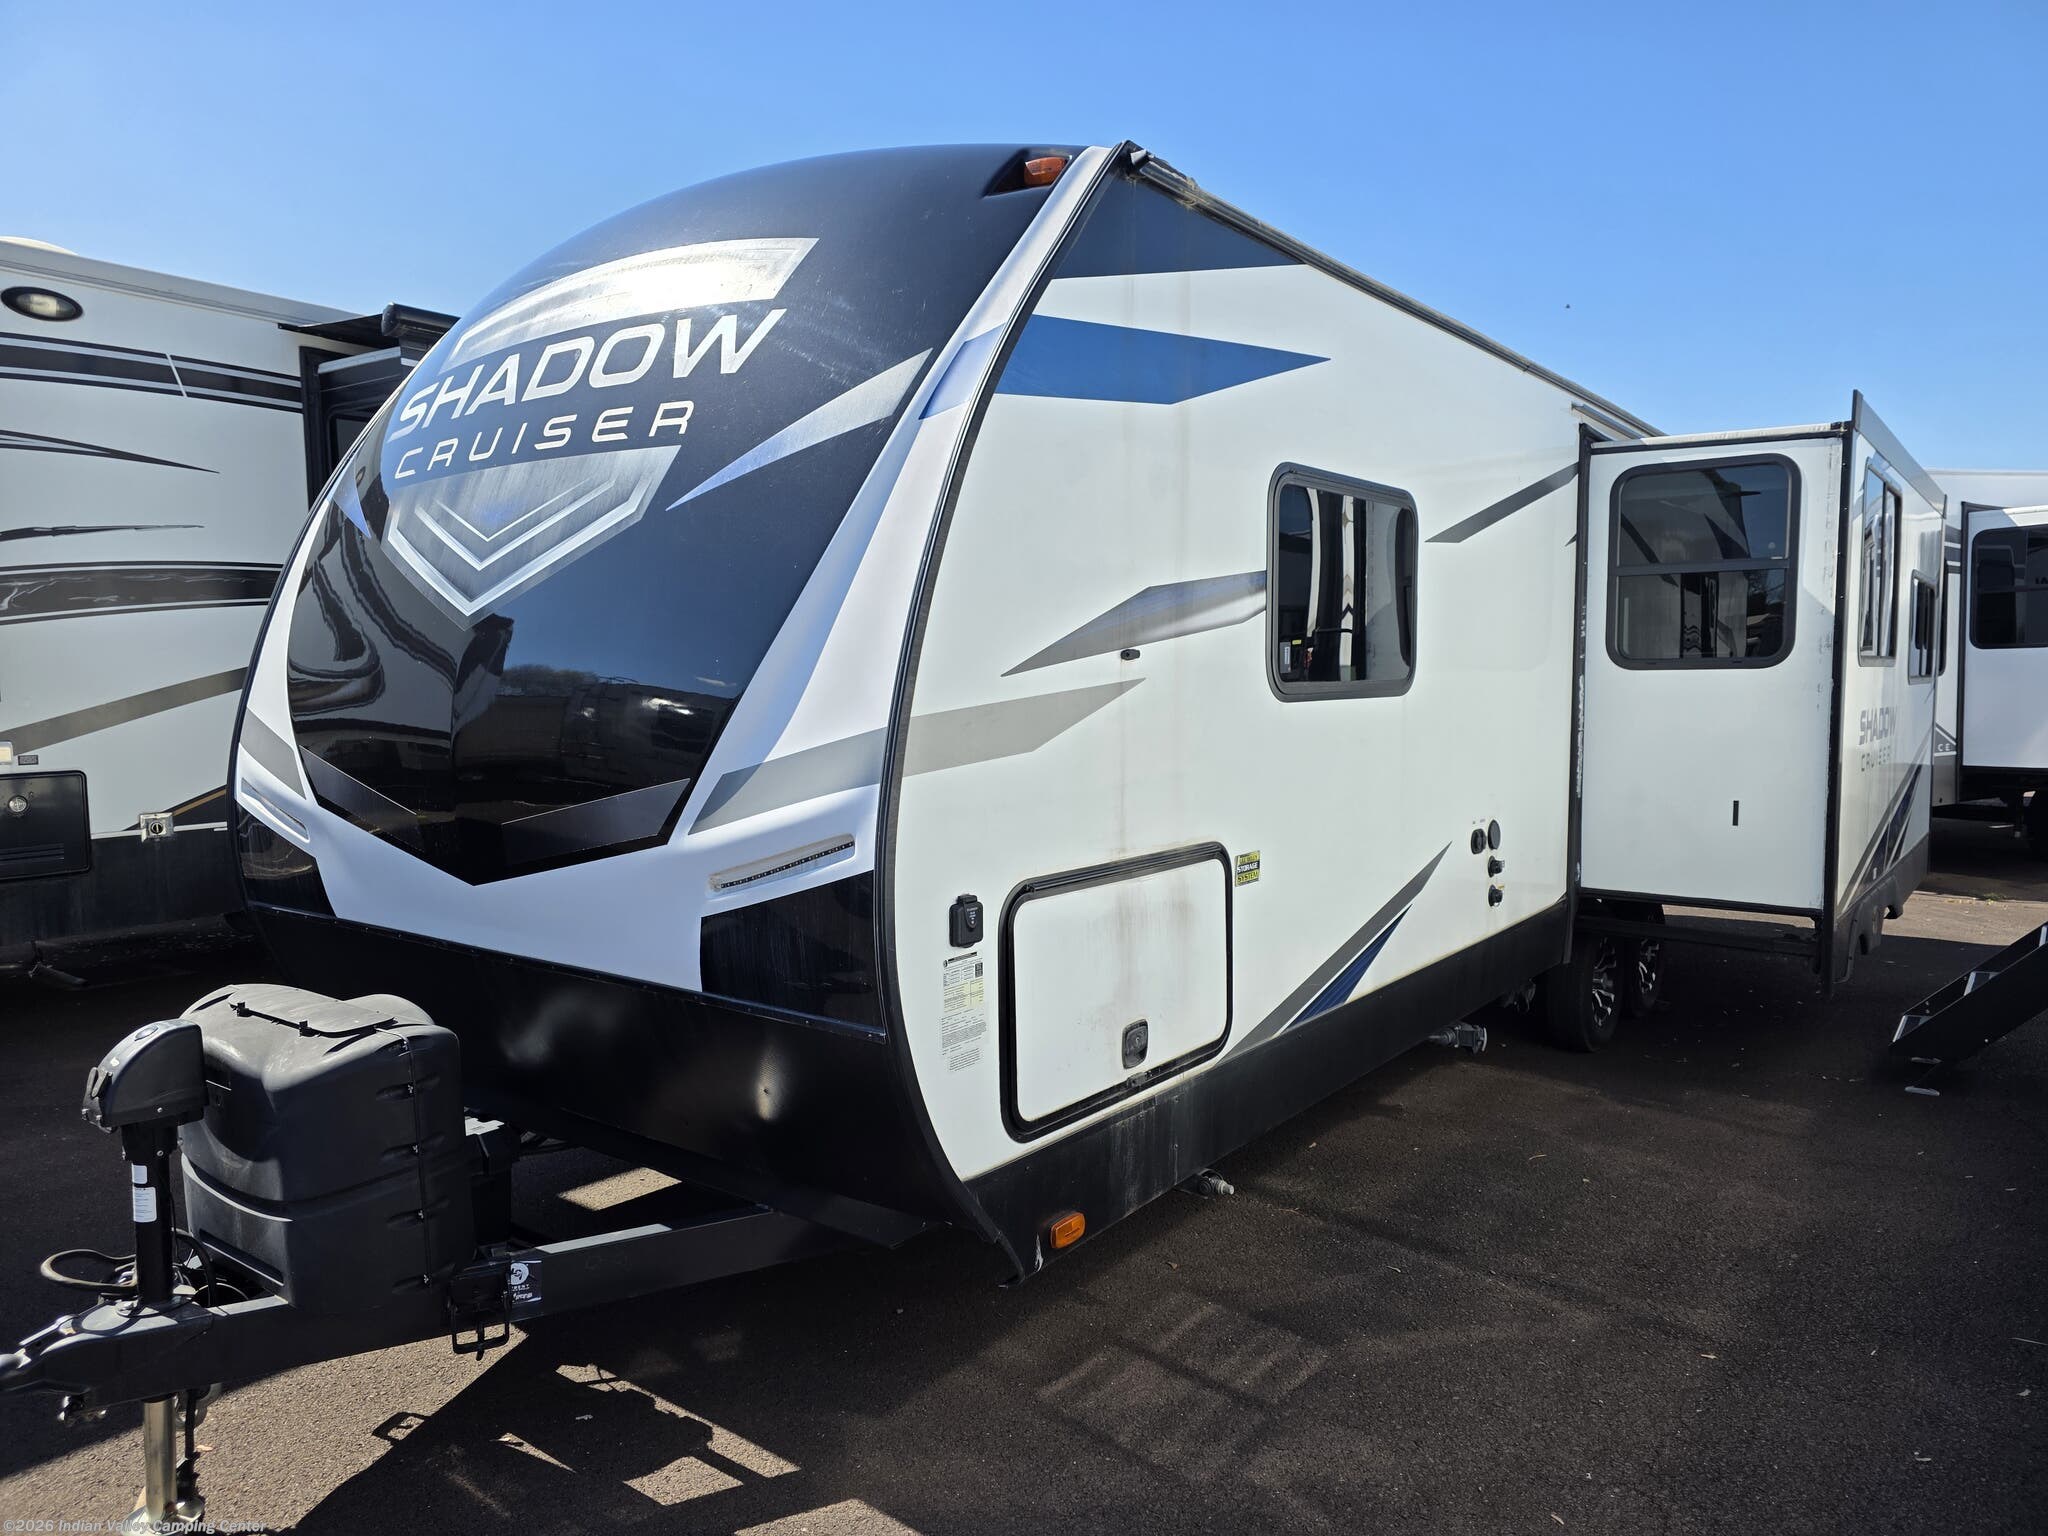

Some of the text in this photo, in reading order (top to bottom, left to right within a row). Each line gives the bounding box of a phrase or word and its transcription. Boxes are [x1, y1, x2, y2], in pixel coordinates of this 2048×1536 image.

[387, 308, 787, 442] SHADOW
[394, 400, 695, 479] CRUISER
[1859, 706, 1897, 745] SHADOW
[1938, 744, 1951, 752] CE
